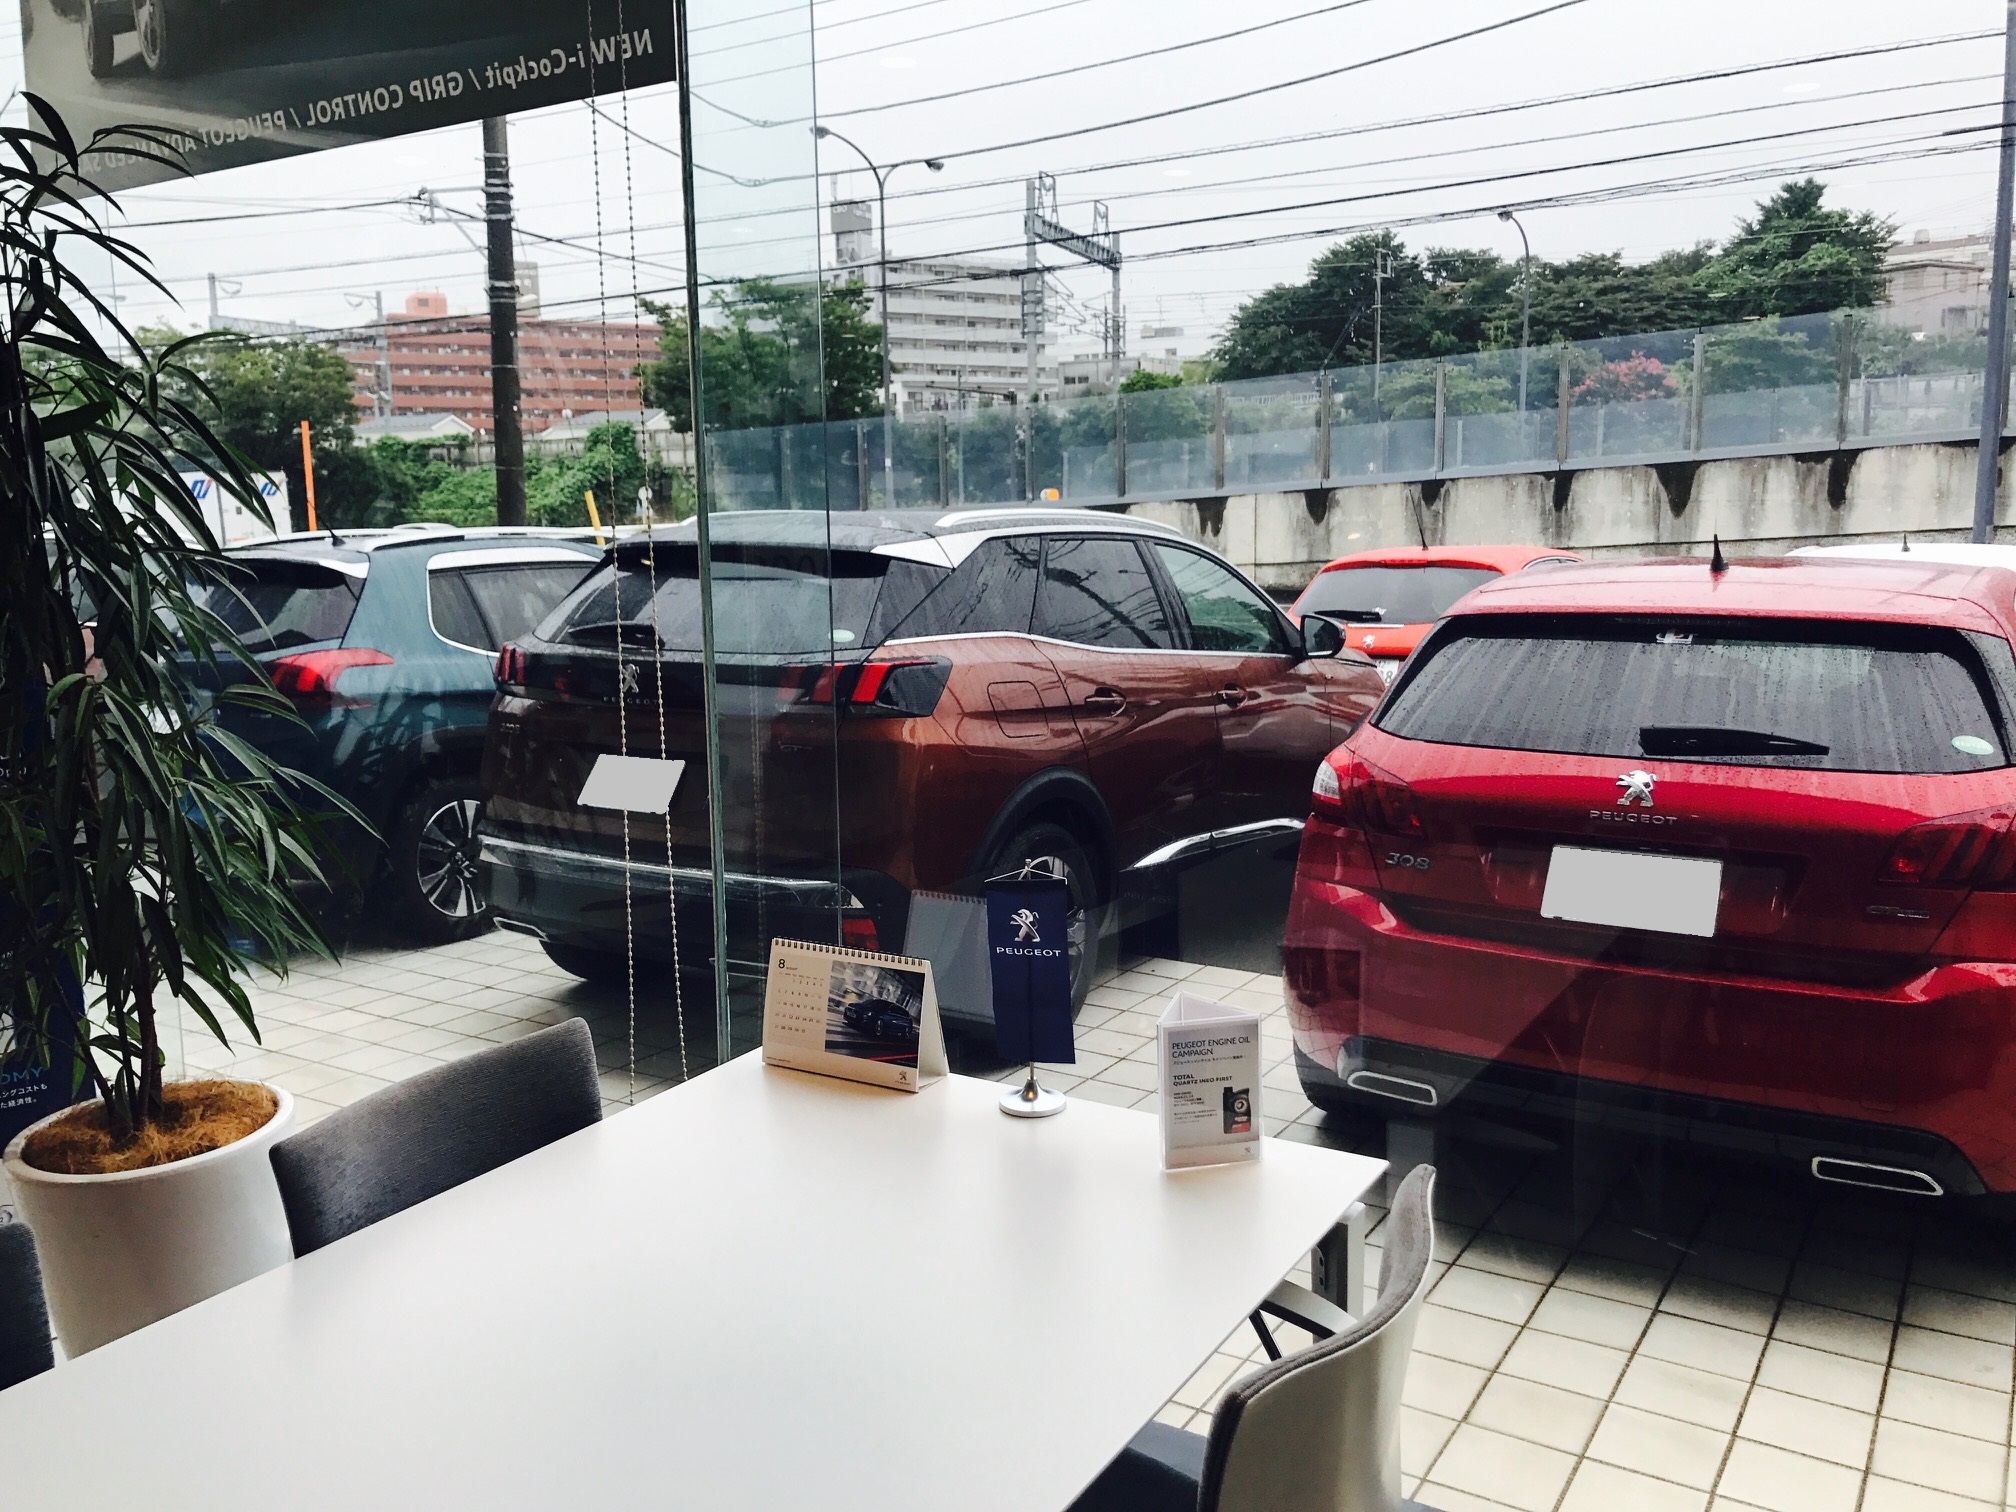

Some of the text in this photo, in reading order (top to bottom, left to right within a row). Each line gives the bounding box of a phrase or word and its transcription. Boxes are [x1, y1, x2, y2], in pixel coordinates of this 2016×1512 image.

[1589, 810, 1678, 826] PEUGEOT
[1385, 852, 1430, 870] 308
[996, 946, 1062, 957] PEUGEOT
[778, 958, 786, 969] 8
[1172, 1036, 1251, 1050] PEUGEOT ENGINE OIL
[1172, 1048, 1213, 1058] CAMPAIGN
[1173, 1079, 1198, 1087] QUARTZ
